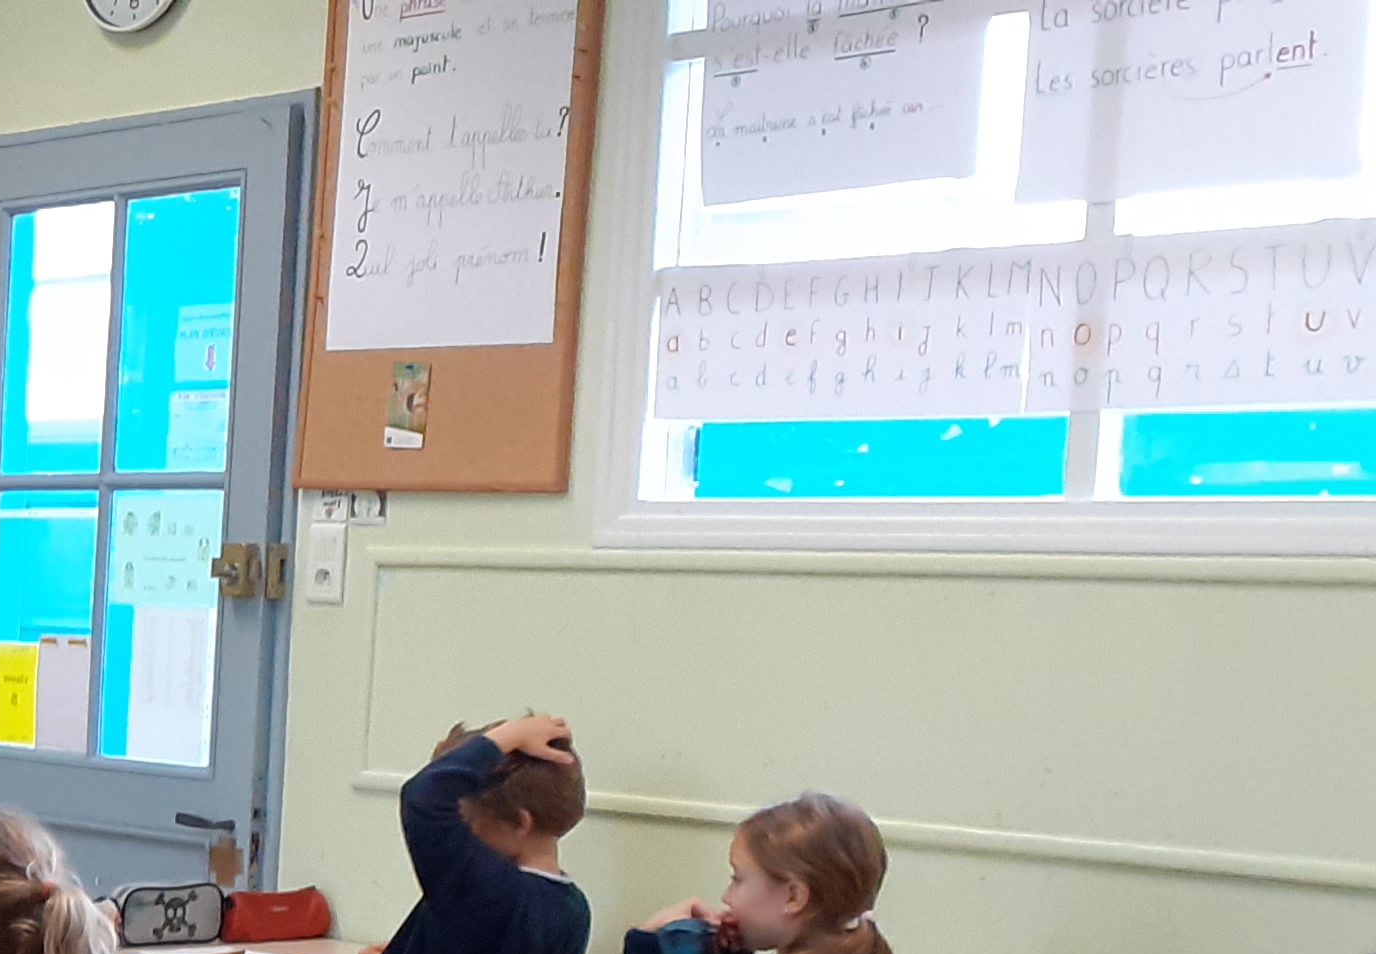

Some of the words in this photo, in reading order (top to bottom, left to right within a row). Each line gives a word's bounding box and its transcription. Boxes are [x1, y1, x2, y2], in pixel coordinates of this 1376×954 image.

[712, 1, 790, 31] Pourquoi
[393, 23, 461, 52] majuscule
[411, 54, 456, 84] point.
[1035, 60, 1072, 94] Les
[1091, 52, 1197, 88] sorcières
[353, 179, 380, 233] Je
[346, 239, 395, 278] Quel
